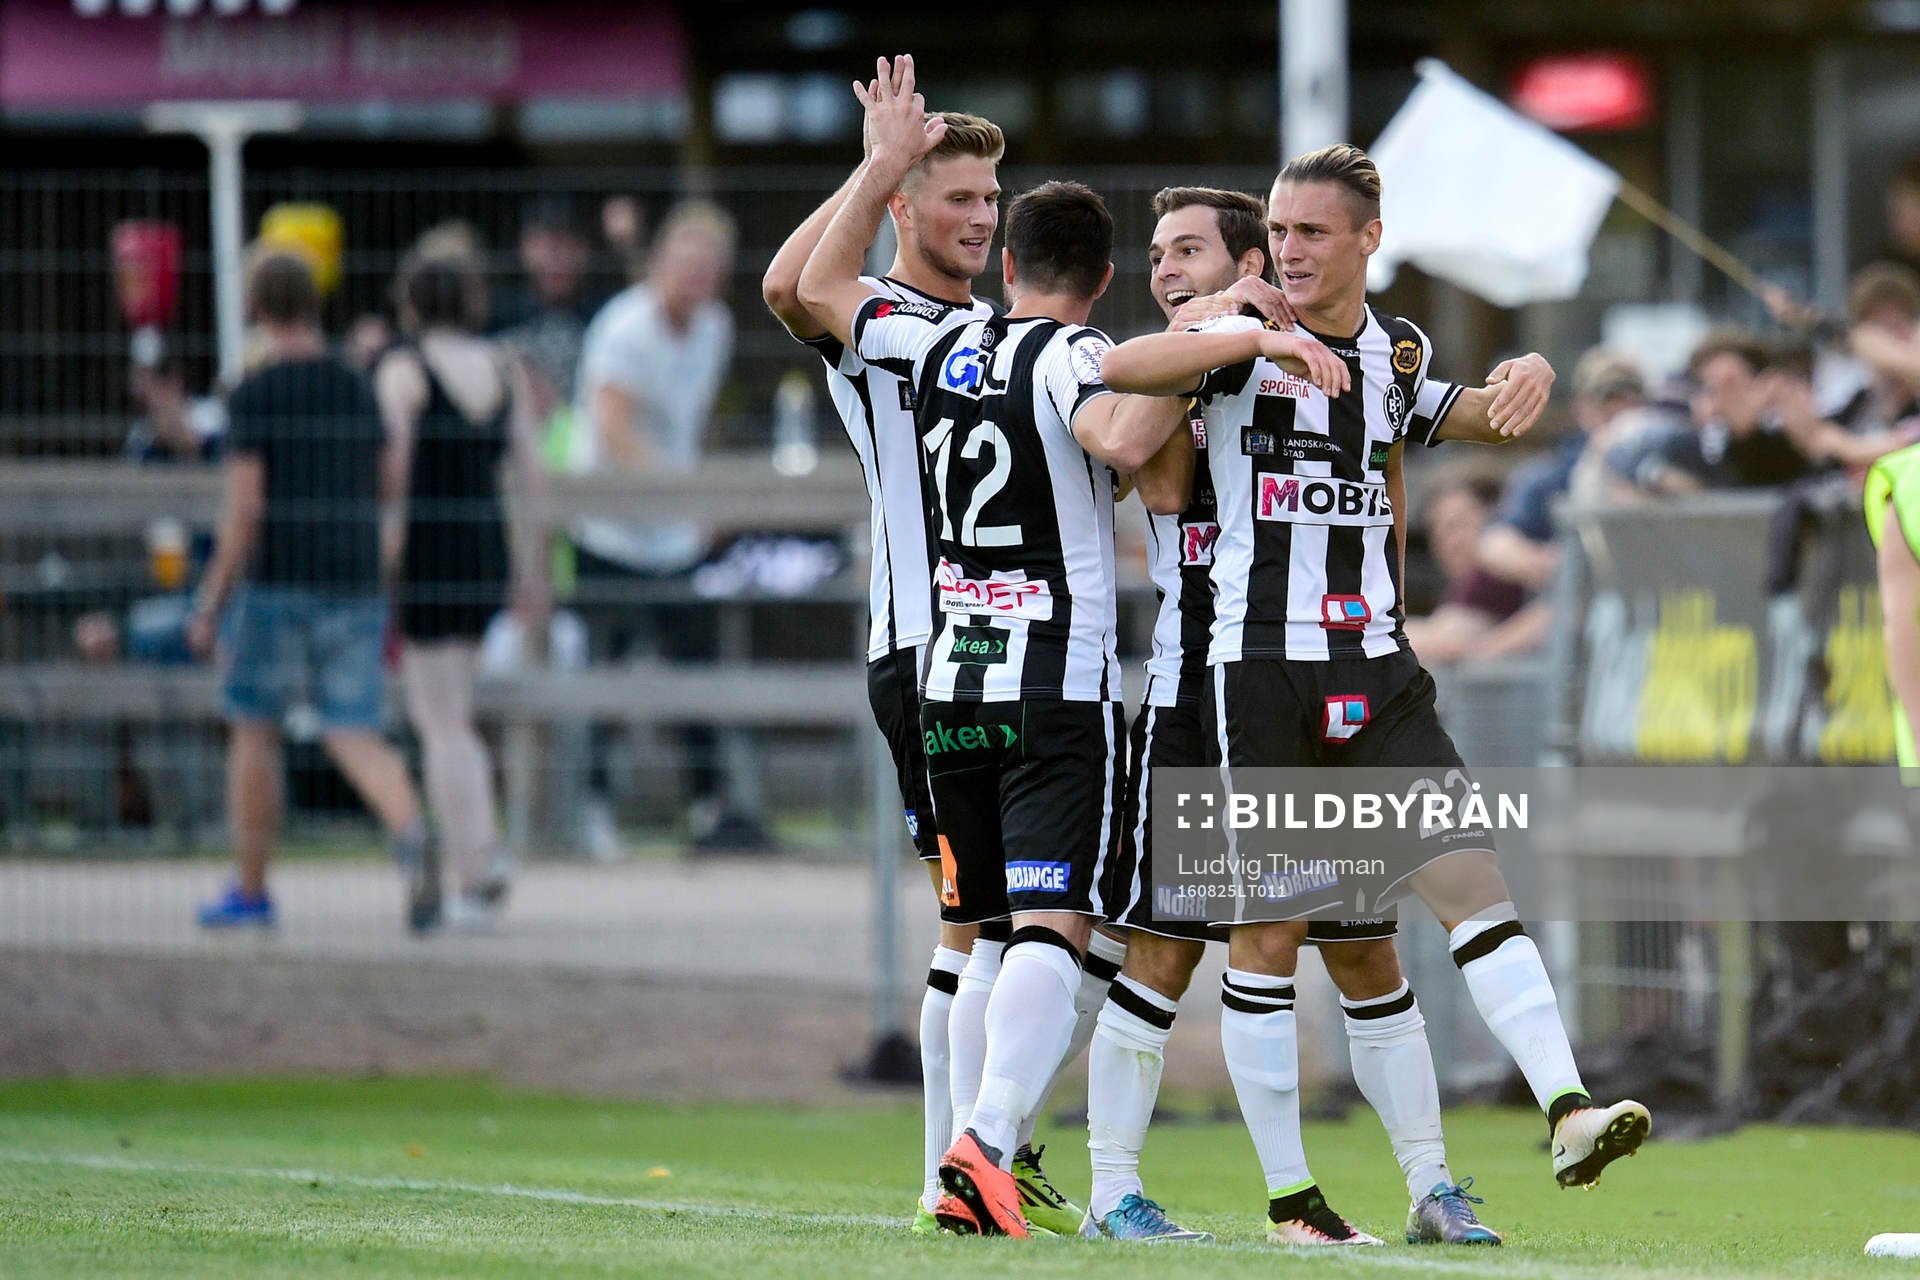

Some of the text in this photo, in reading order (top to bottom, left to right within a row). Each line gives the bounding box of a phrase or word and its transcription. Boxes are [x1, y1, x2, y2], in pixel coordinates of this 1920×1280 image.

[1259, 379, 1310, 399] SPORTIA
[1282, 448, 1305, 459] STAD
[922, 417, 1024, 547] 12
[925, 720, 991, 756] akea
